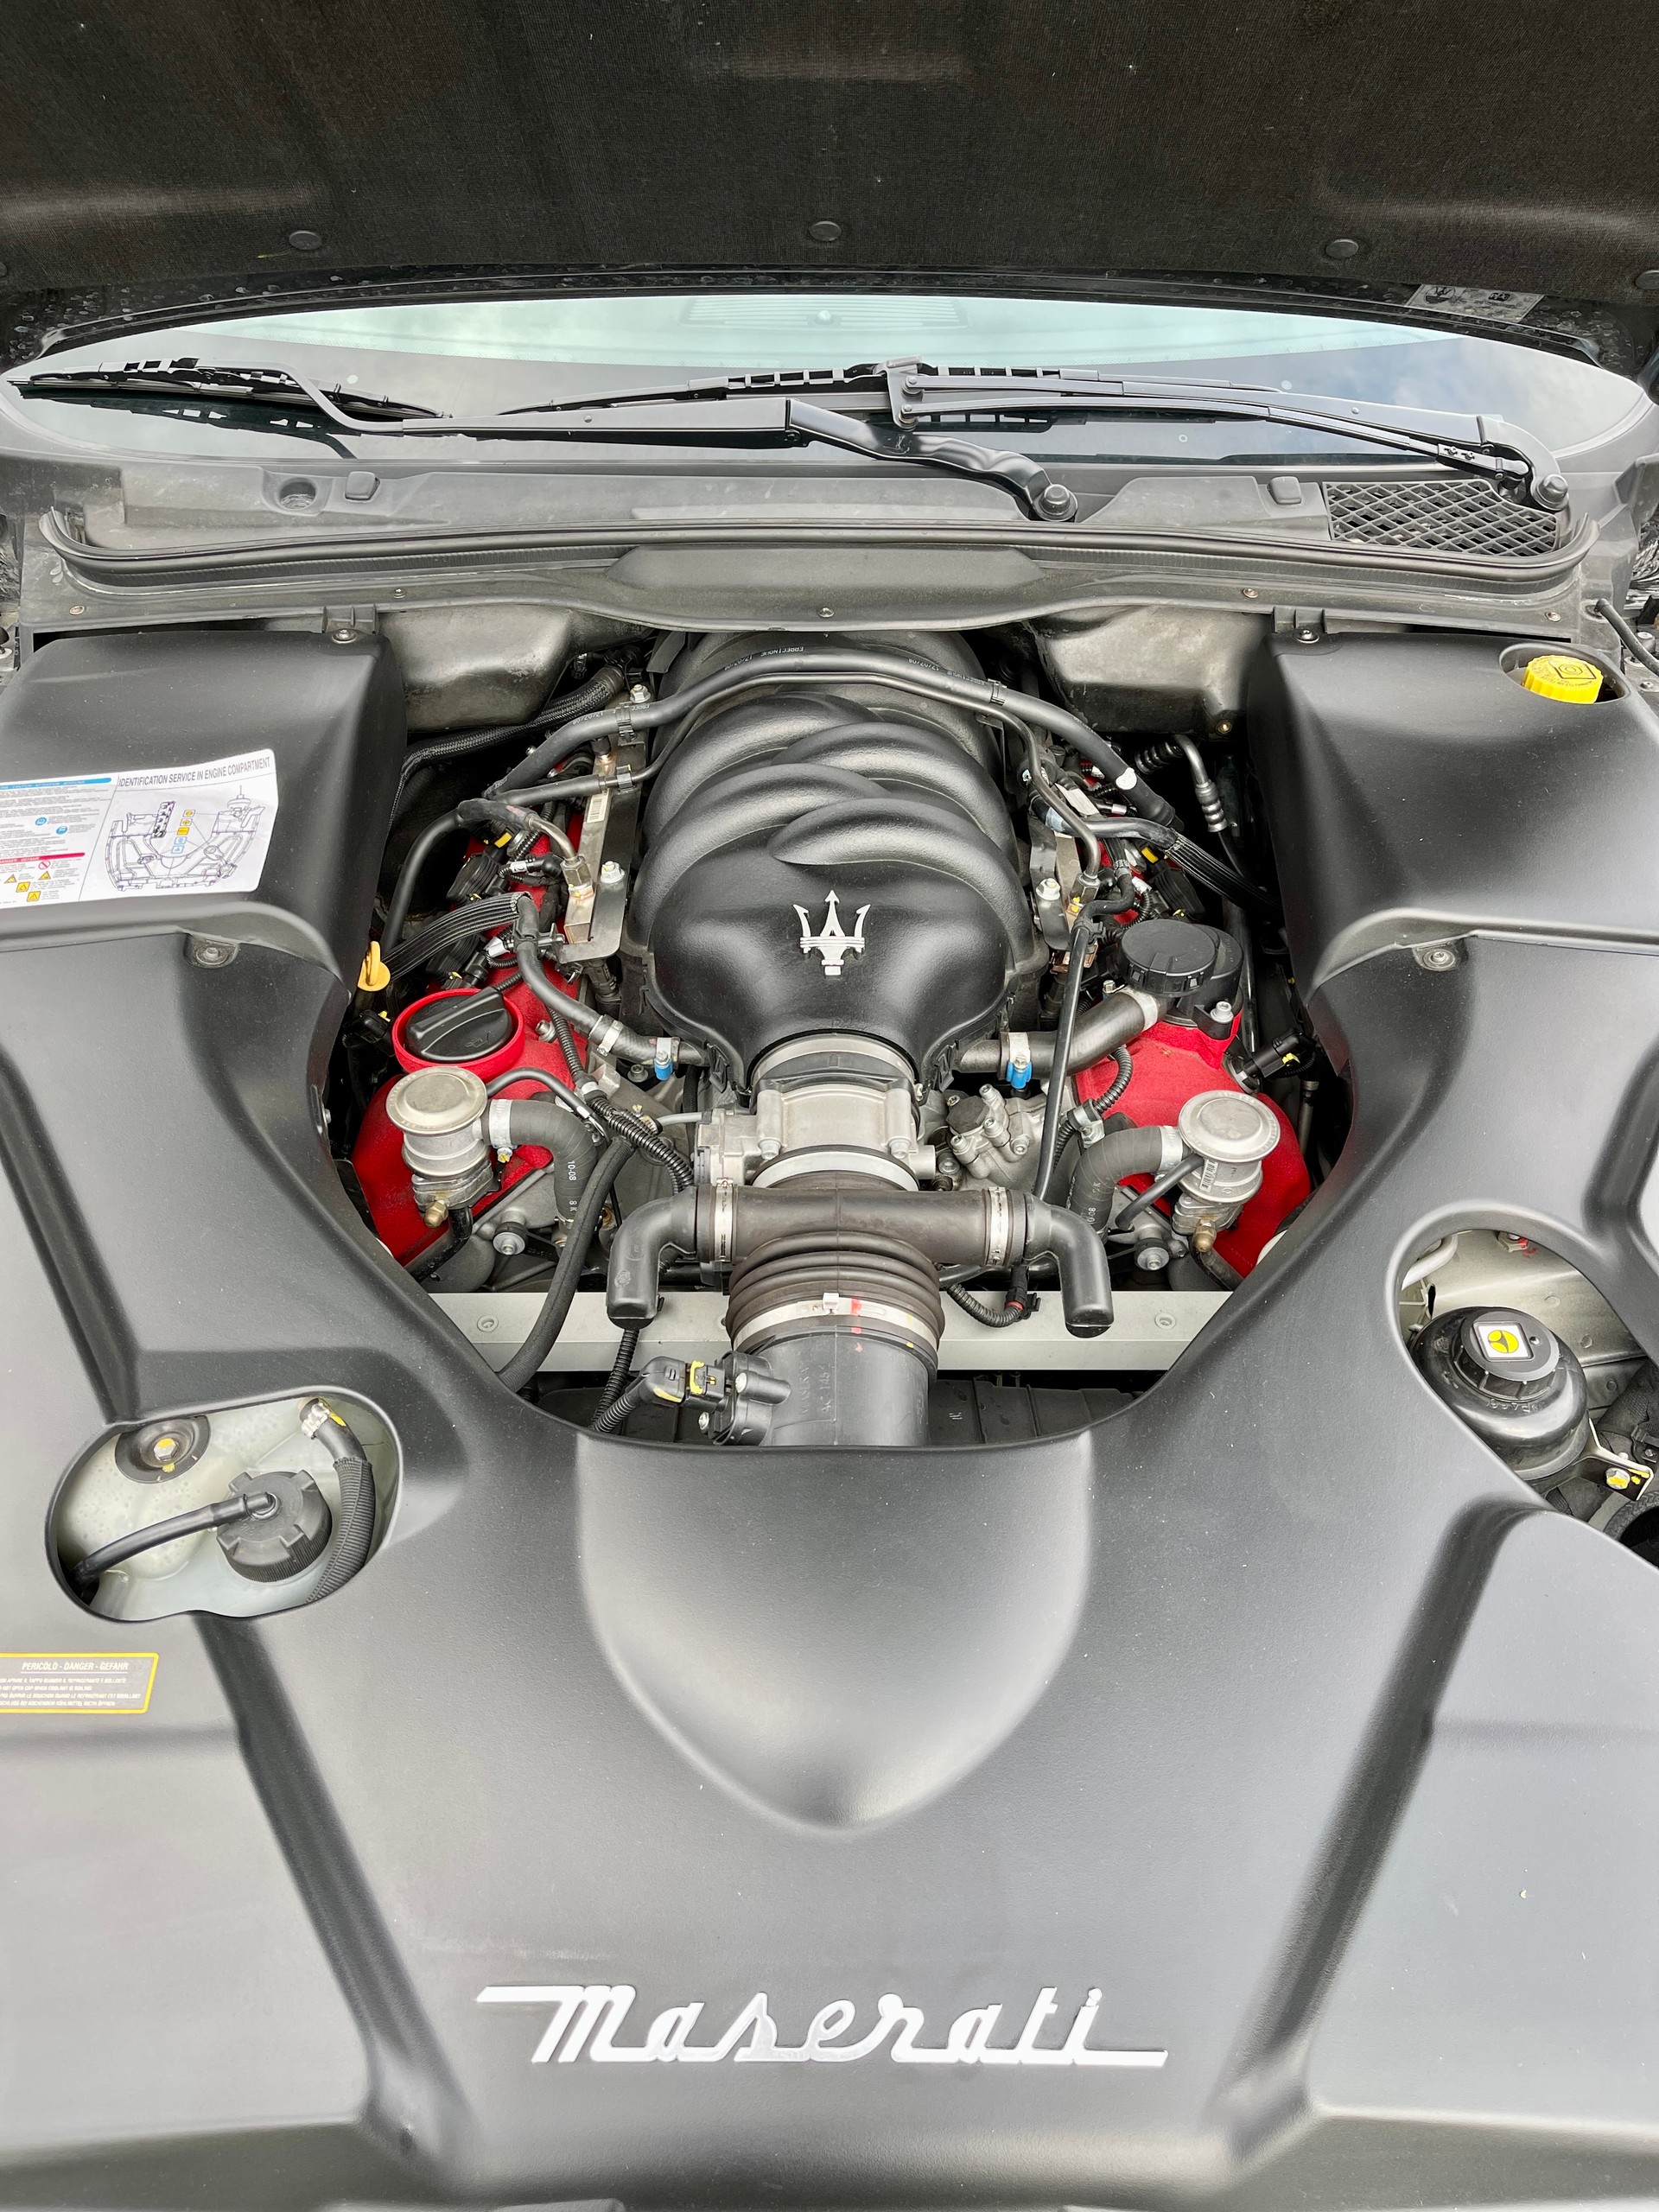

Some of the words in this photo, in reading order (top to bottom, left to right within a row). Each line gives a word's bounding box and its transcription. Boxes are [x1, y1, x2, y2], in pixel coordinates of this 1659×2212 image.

[118, 774, 168, 787] IDENTIFICATION
[168, 772, 196, 783] SERVICE
[197, 771, 204, 780] IN
[205, 766, 226, 779] ENGINE
[227, 757, 270, 776] COMPARTMENT
[22, 1662, 58, 1670] PERICOLO
[63, 1662, 94, 1670] DANGER
[99, 1662, 129, 1670] GEFAHR
[475, 1984, 1169, 2069] Maserati
